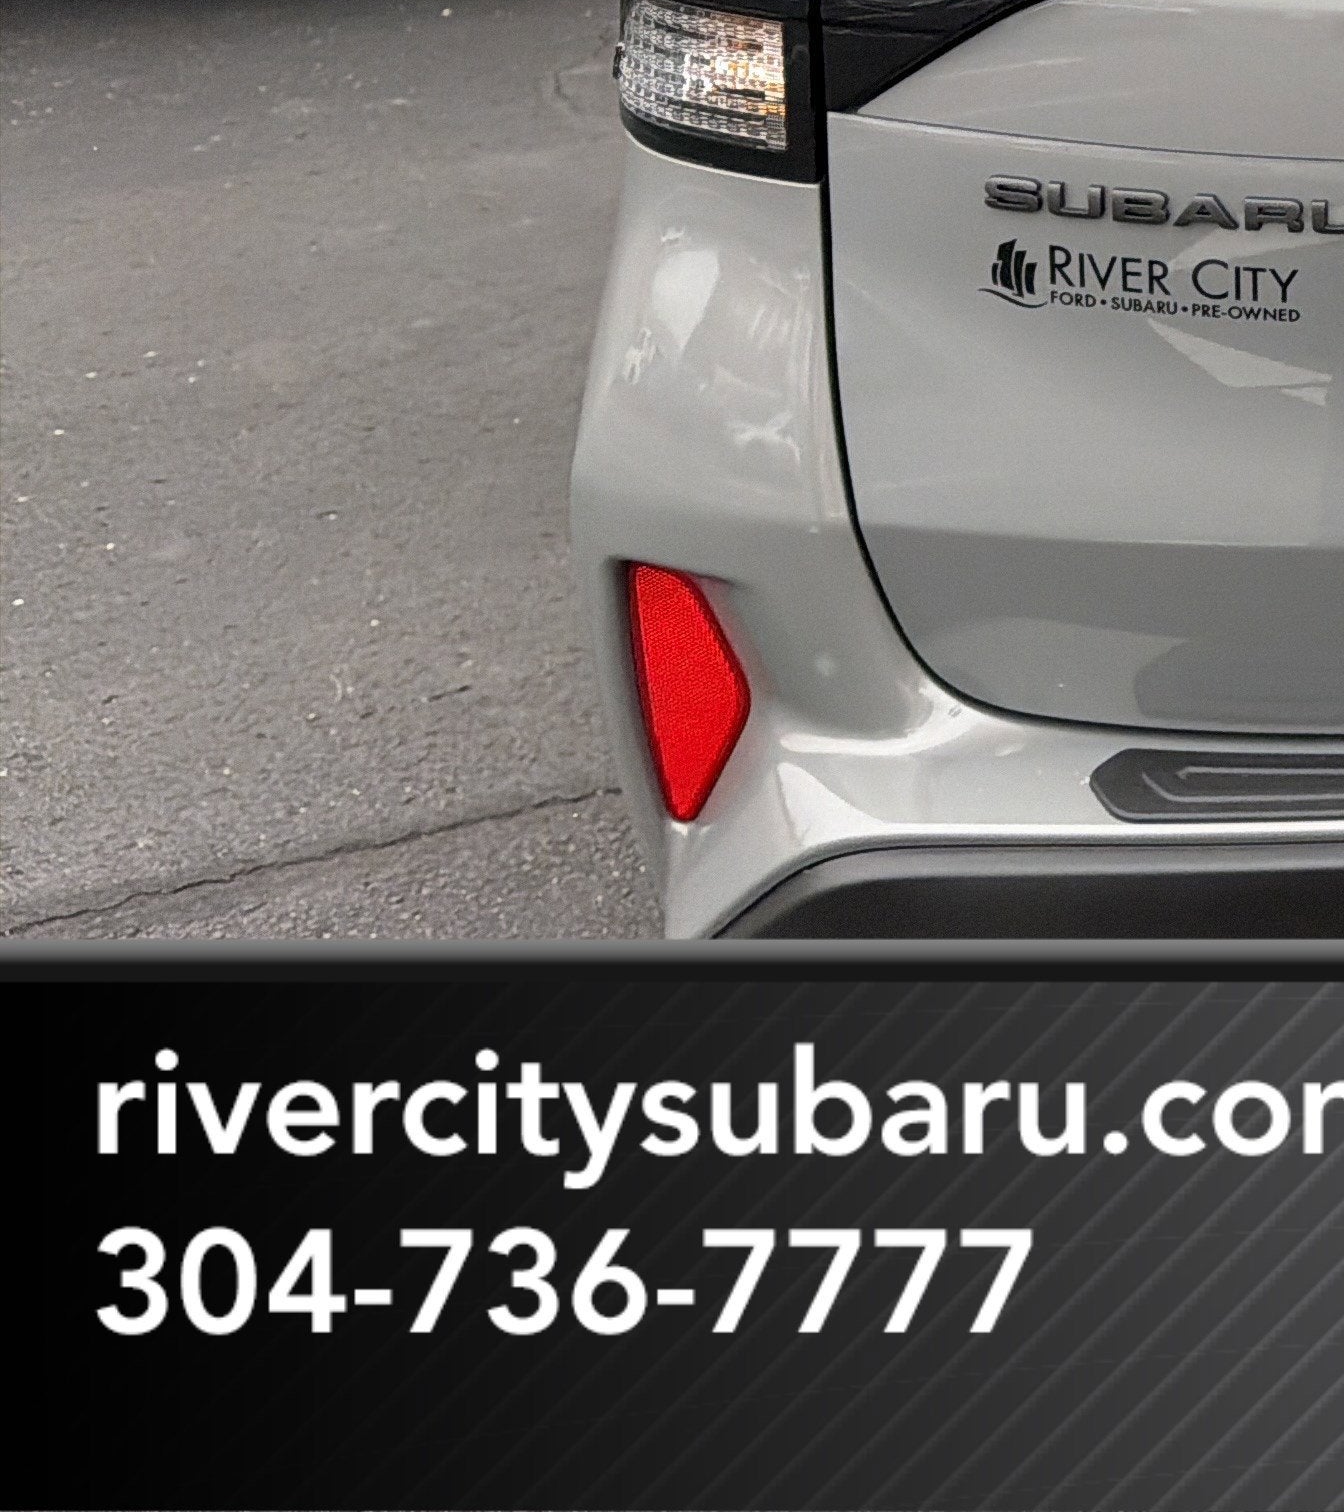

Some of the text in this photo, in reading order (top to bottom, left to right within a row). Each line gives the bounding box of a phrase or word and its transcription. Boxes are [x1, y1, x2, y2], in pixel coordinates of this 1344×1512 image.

[1048, 244, 1300, 303] RIVER CITY
[1050, 290, 1301, 323] FORD SUBARU PRE-OWNED
